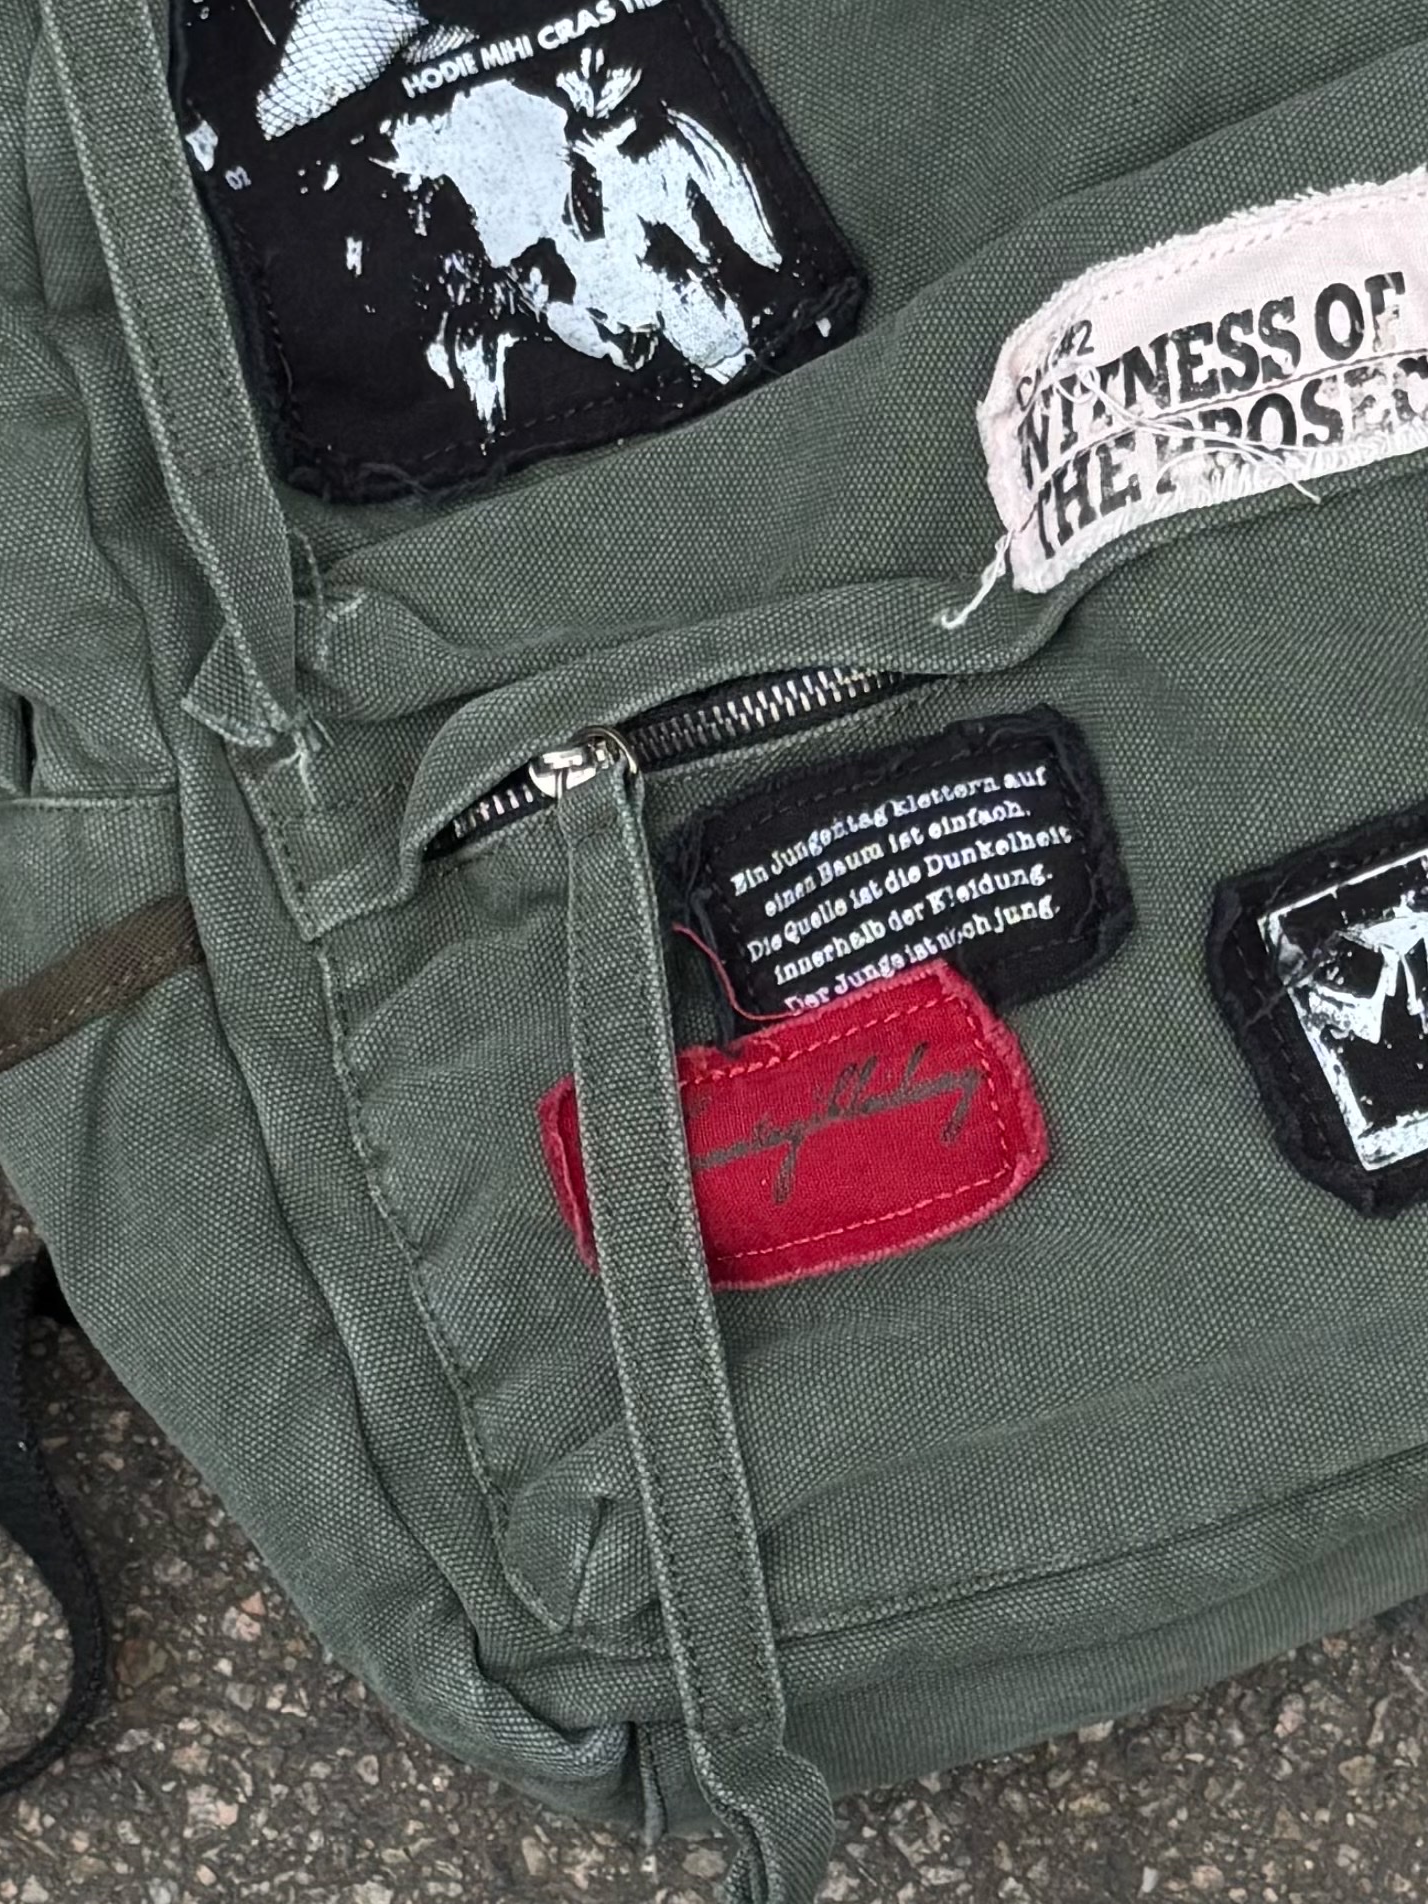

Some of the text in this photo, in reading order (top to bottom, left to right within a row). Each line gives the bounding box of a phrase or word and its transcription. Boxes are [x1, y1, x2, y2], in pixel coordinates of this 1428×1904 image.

[401, 52, 478, 99] HODIE
[480, 35, 533, 70] MIHI
[537, 0, 617, 50] CRAS
[1037, 429, 1143, 560] THE
[730, 865, 770, 897] Ein
[890, 776, 1001, 818] klettern
[1003, 765, 1048, 790] auf
[764, 799, 1032, 918] einen Baum ist einfach.
[746, 825, 1073, 964] Die Quelle ist die Dunkelheit
[774, 863, 1054, 986] innerhalb der Kleidung.
[784, 986, 830, 1014] Der
[833, 950, 906, 996] Junge
[905, 936, 938, 964] ist
